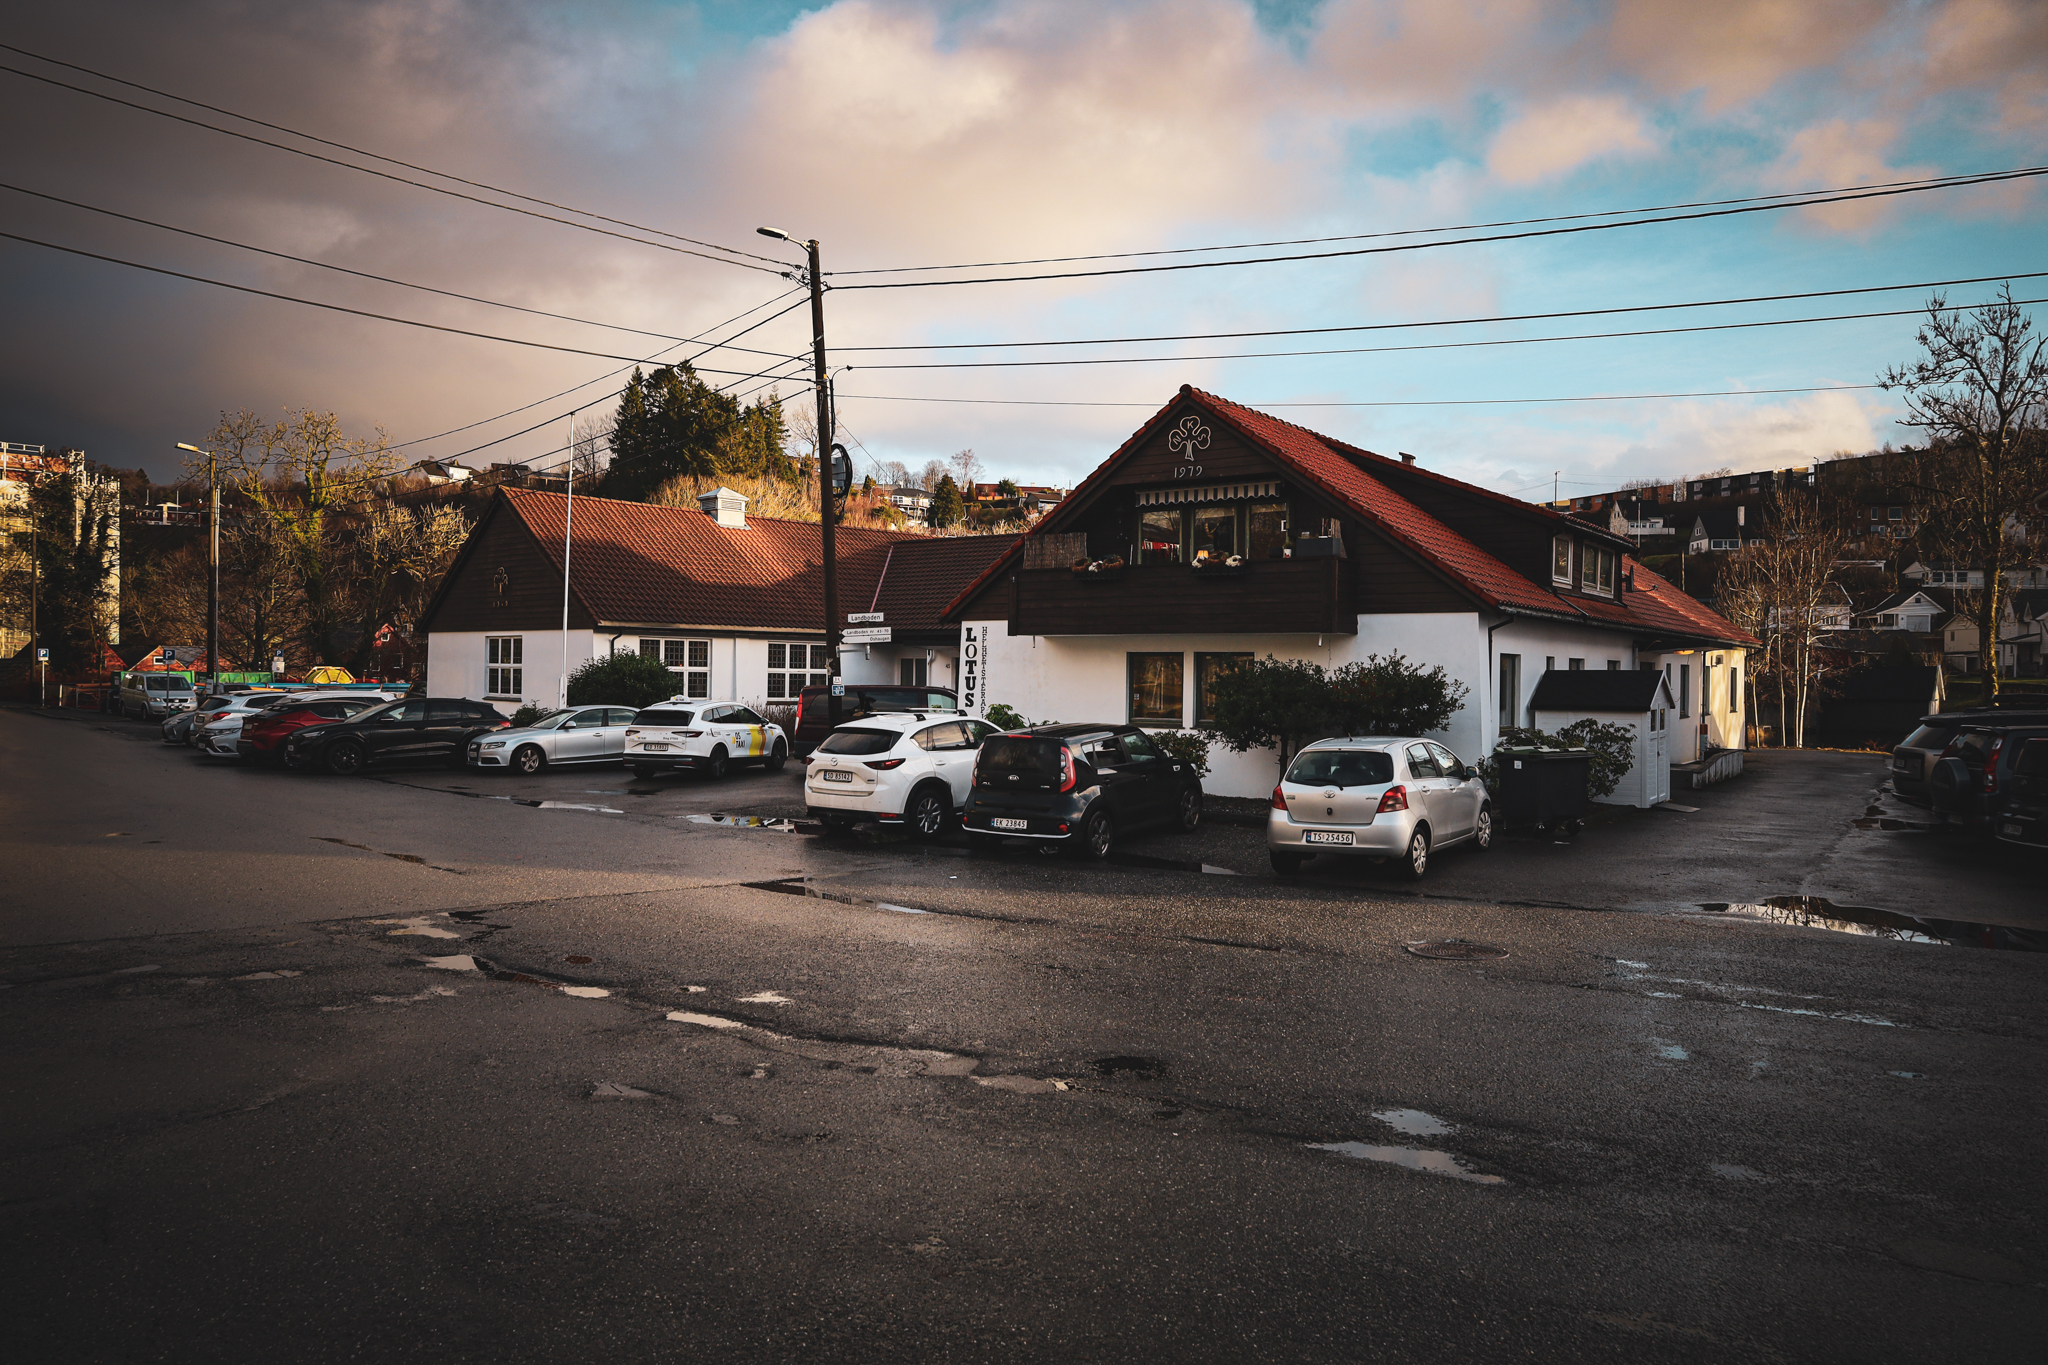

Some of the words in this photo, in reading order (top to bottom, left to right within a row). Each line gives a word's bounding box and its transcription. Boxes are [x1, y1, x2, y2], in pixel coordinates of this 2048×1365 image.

[1174, 465, 1203, 479] 1979
[851, 614, 881, 622] Landboden
[965, 627, 977, 708] LOTUS
[735, 740, 746, 748] TAXI
[1313, 833, 1322, 841] TS
[1326, 833, 1350, 843] 25456
